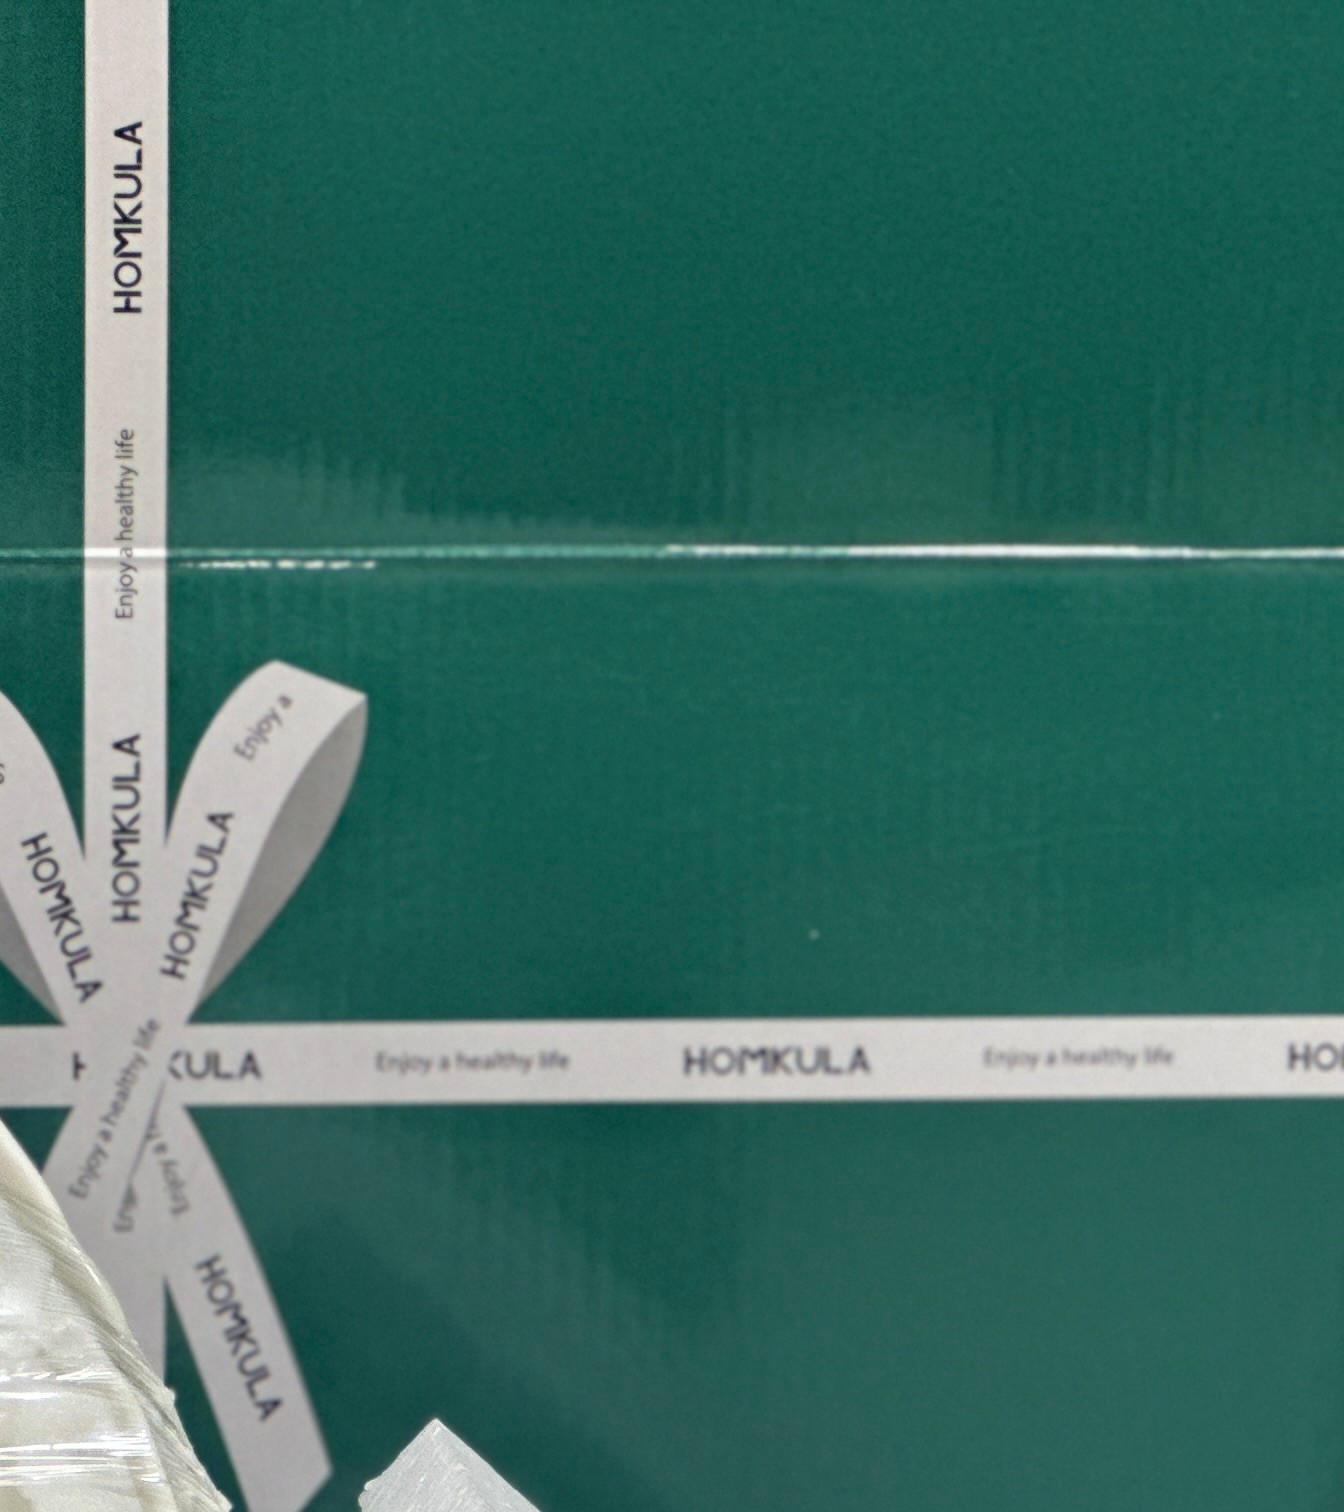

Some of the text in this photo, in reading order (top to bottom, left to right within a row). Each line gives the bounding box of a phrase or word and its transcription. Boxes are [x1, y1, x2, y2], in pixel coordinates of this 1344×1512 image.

[113, 121, 143, 314] HOMKULA
[114, 428, 138, 619] Enjoy a healthy life
[233, 694, 293, 761] Enjoy a
[112, 734, 141, 922] HOMKULA
[160, 812, 234, 980] HOMKULA
[21, 832, 103, 1004] HOMKULA
[68, 1018, 160, 1200] Enjoy a healthy life
[375, 1048, 570, 1076] Enjoy a healthy life
[683, 1046, 871, 1077] HOMKULA
[982, 1046, 1174, 1073] Enjoy a healthy life
[195, 1253, 285, 1423] HOMKULA
